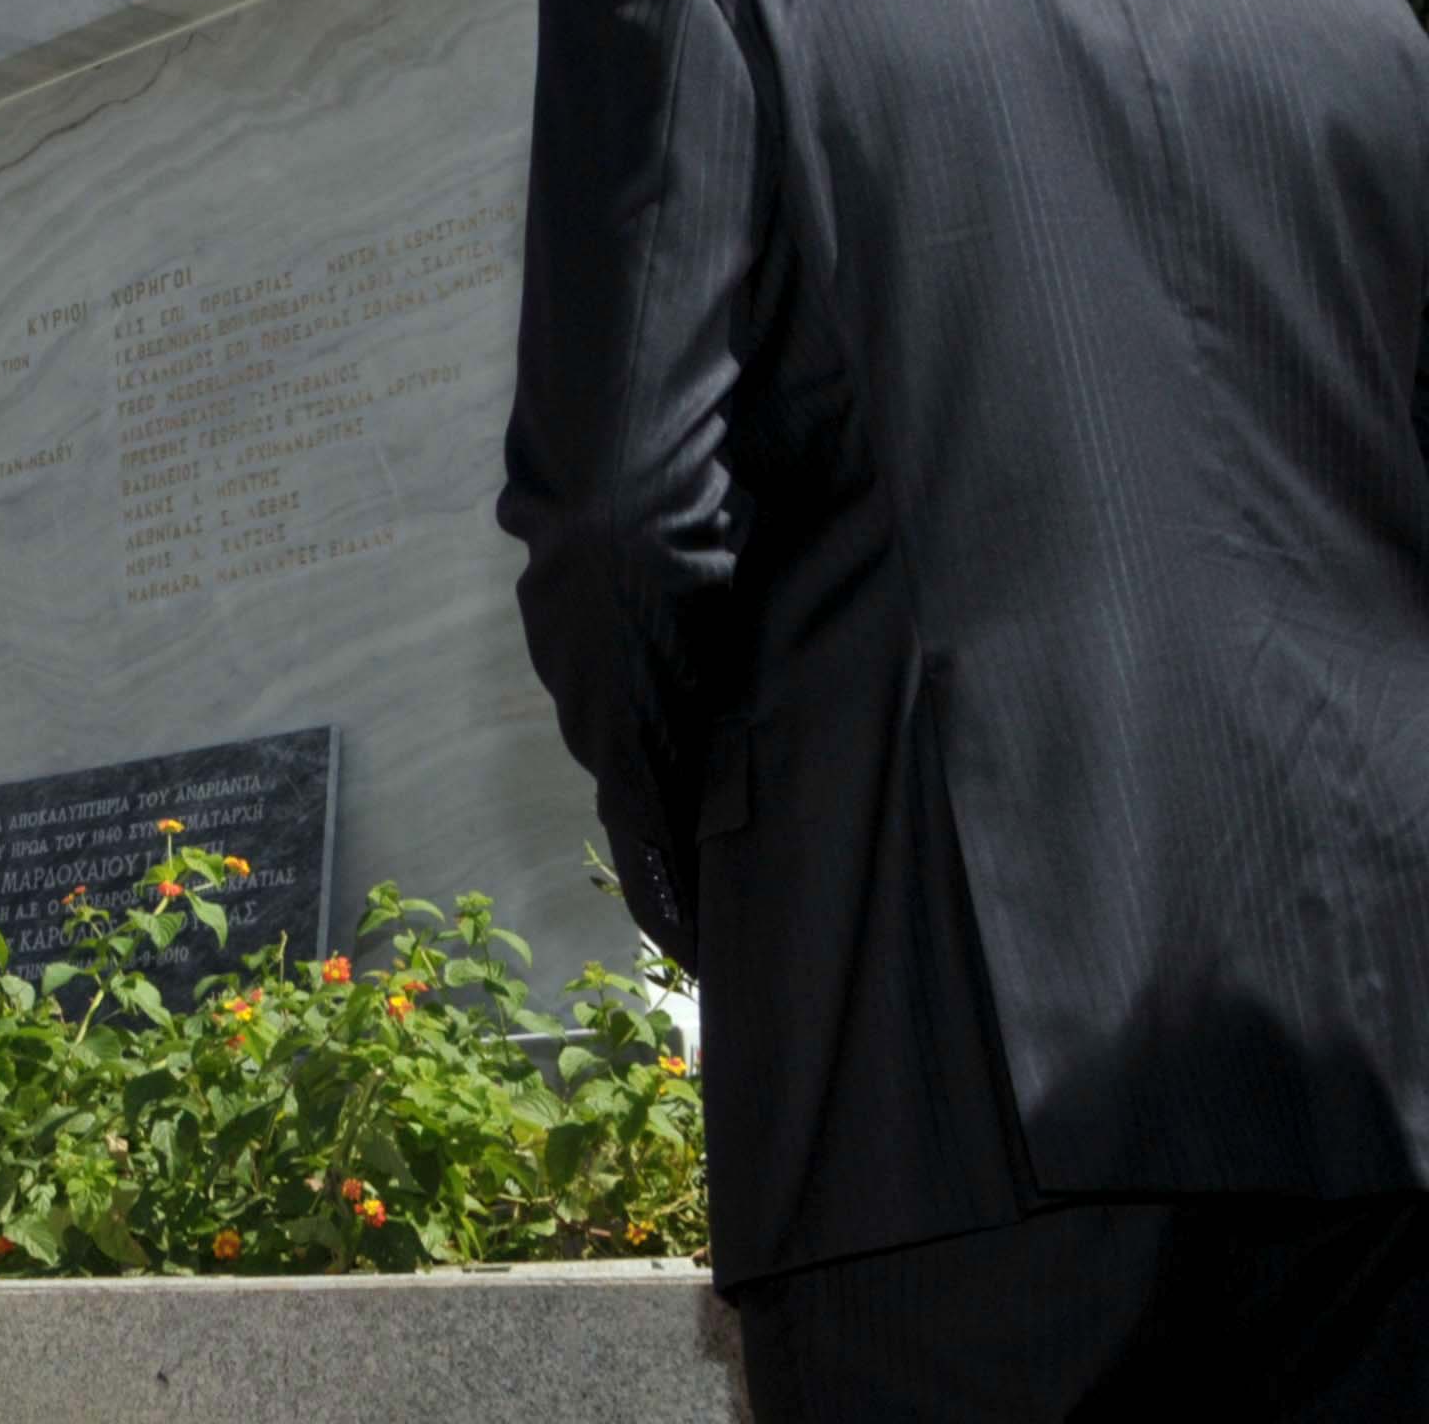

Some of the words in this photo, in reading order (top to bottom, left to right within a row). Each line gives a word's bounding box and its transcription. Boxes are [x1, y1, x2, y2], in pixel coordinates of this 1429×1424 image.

[26, 299, 88, 337] ΚΥΡΙΟΙ
[110, 265, 193, 310] ΧΟΡΗΓΟΙ
[199, 272, 294, 313] ΠΡΟΕΔΡΙΑΣ
[249, 283, 337, 327] ΠΡΟΕΔΡΙΑΣ
[261, 308, 351, 353] ΠΡΟΕΔΡΙΑΣ
[122, 460, 200, 497] ΒΑΣΙΛΕΙΟΣ
[124, 495, 173, 528] ΜΑΚΗΣ
[127, 573, 202, 604] ΜΑΡΜΑΡΑ
[8, 795, 130, 831] ΑΠΟΚΑΛΥΠΤΗΡΙΑ
[137, 787, 170, 810] ΤΟΥ
[175, 775, 262, 803] ΑΝΔΡΙΑΝΤΑ
[11, 839, 49, 859] ΗΡΩΑ
[55, 831, 87, 852] ΤΟΥ
[92, 825, 123, 846] 1940
[0, 853, 139, 895] ΜΑΡΔΟΧΑΙΟΥ
[0, 905, 10, 921] Η
[47, 899, 59, 915] Ο
